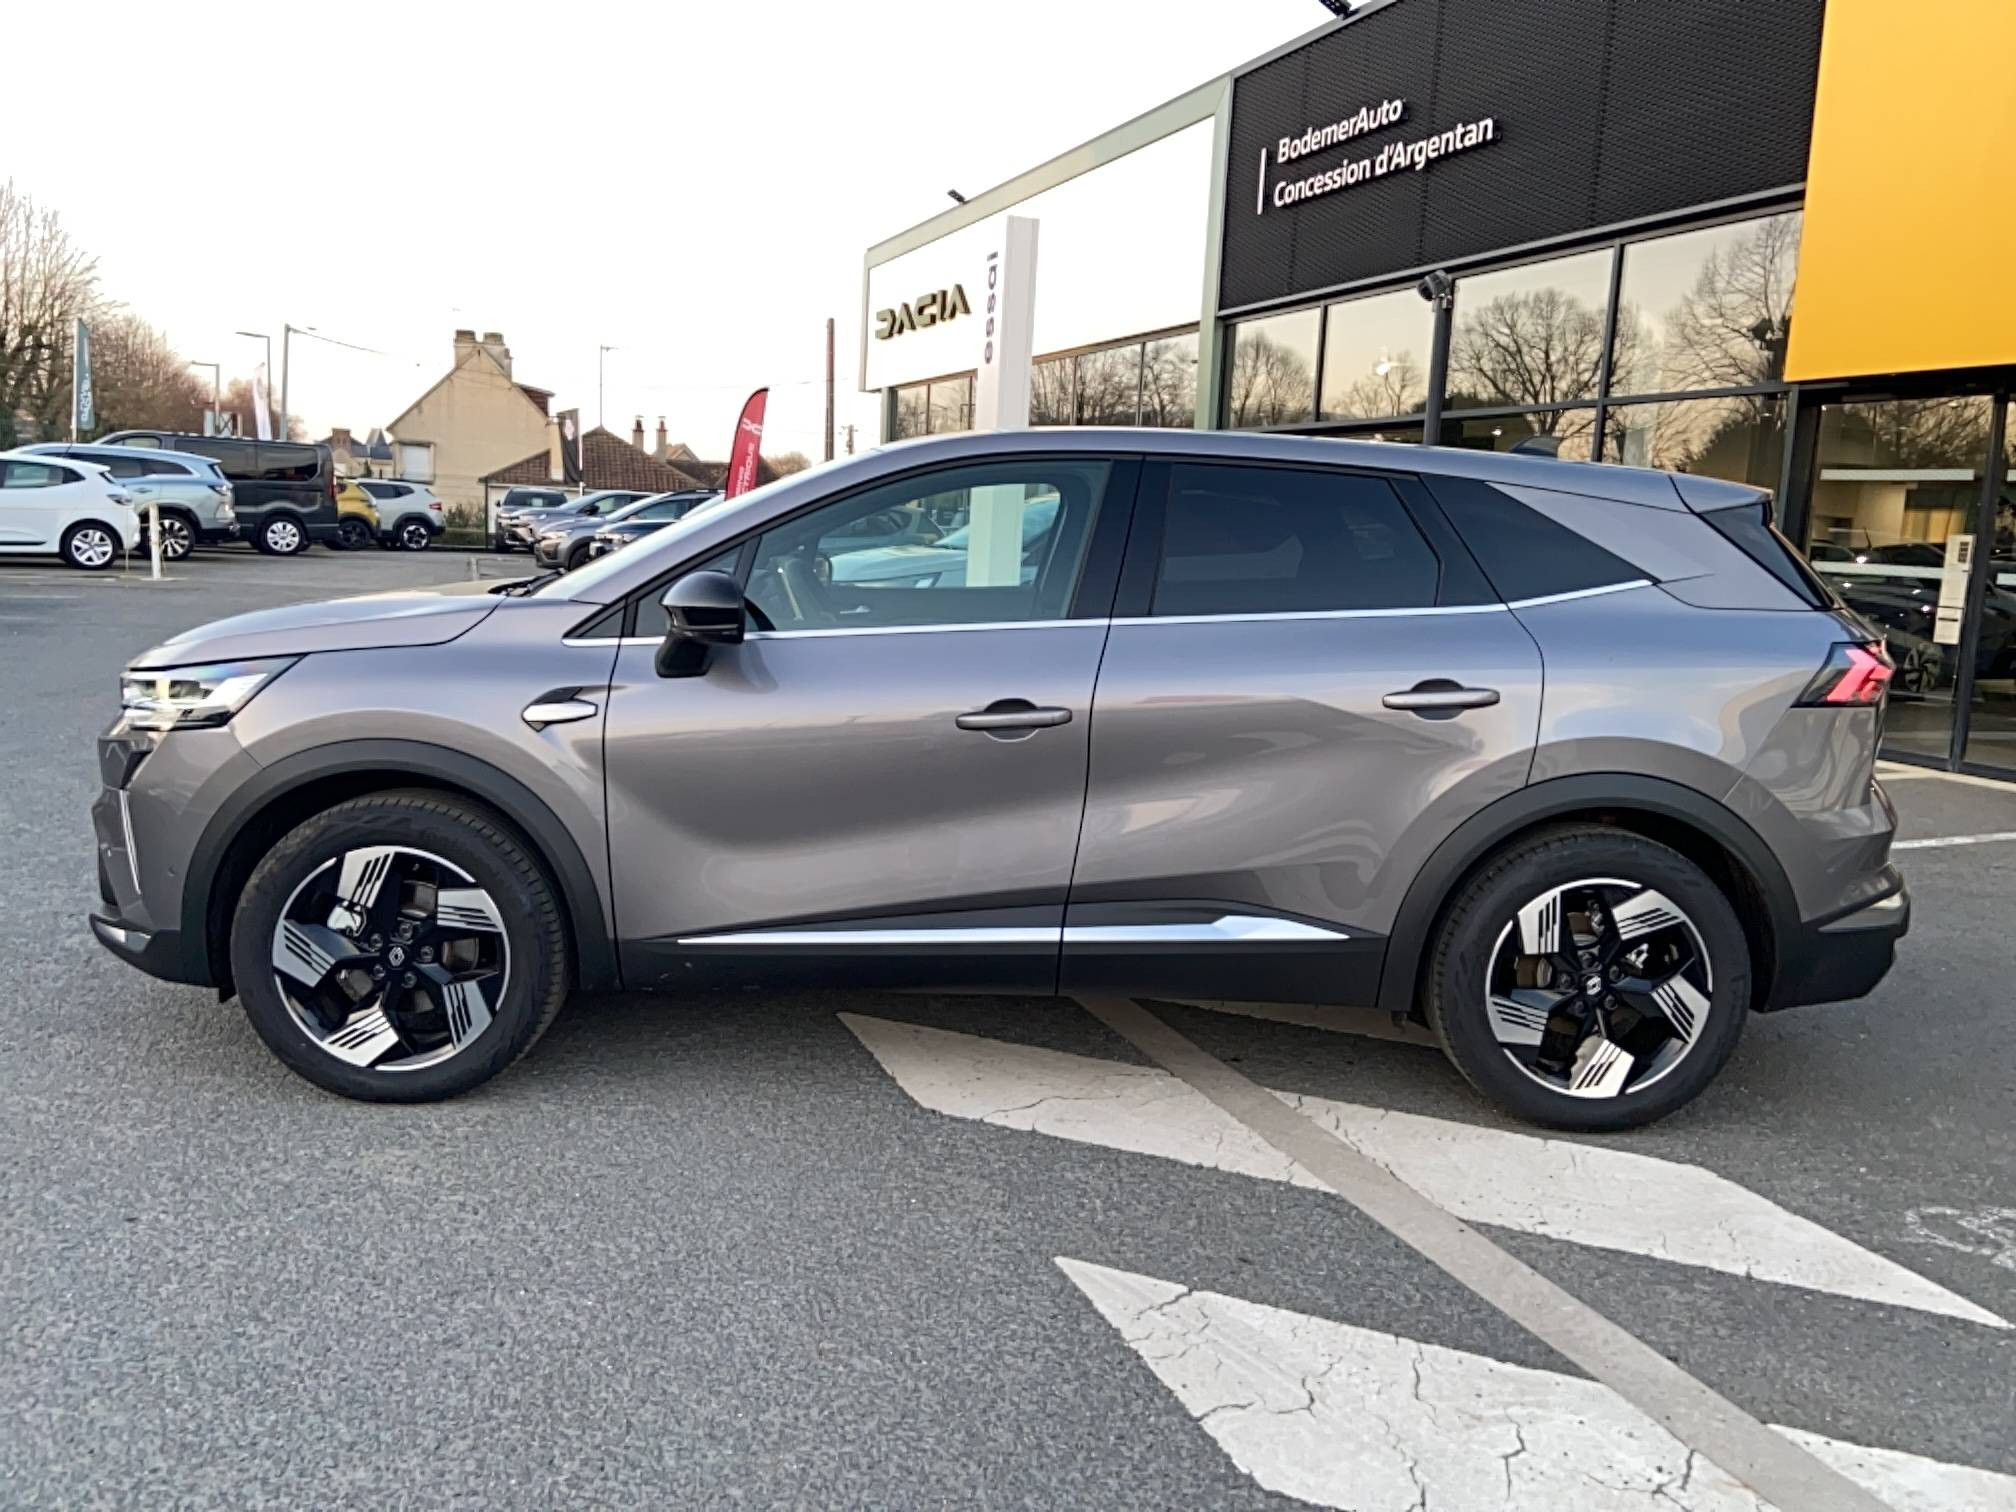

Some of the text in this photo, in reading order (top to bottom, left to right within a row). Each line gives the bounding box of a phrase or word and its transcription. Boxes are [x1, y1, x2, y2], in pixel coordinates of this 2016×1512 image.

[1274, 117, 1494, 208] Concession d'Argentan
[1277, 99, 1404, 163] BodemerAuto
[874, 283, 973, 341] DACIA
